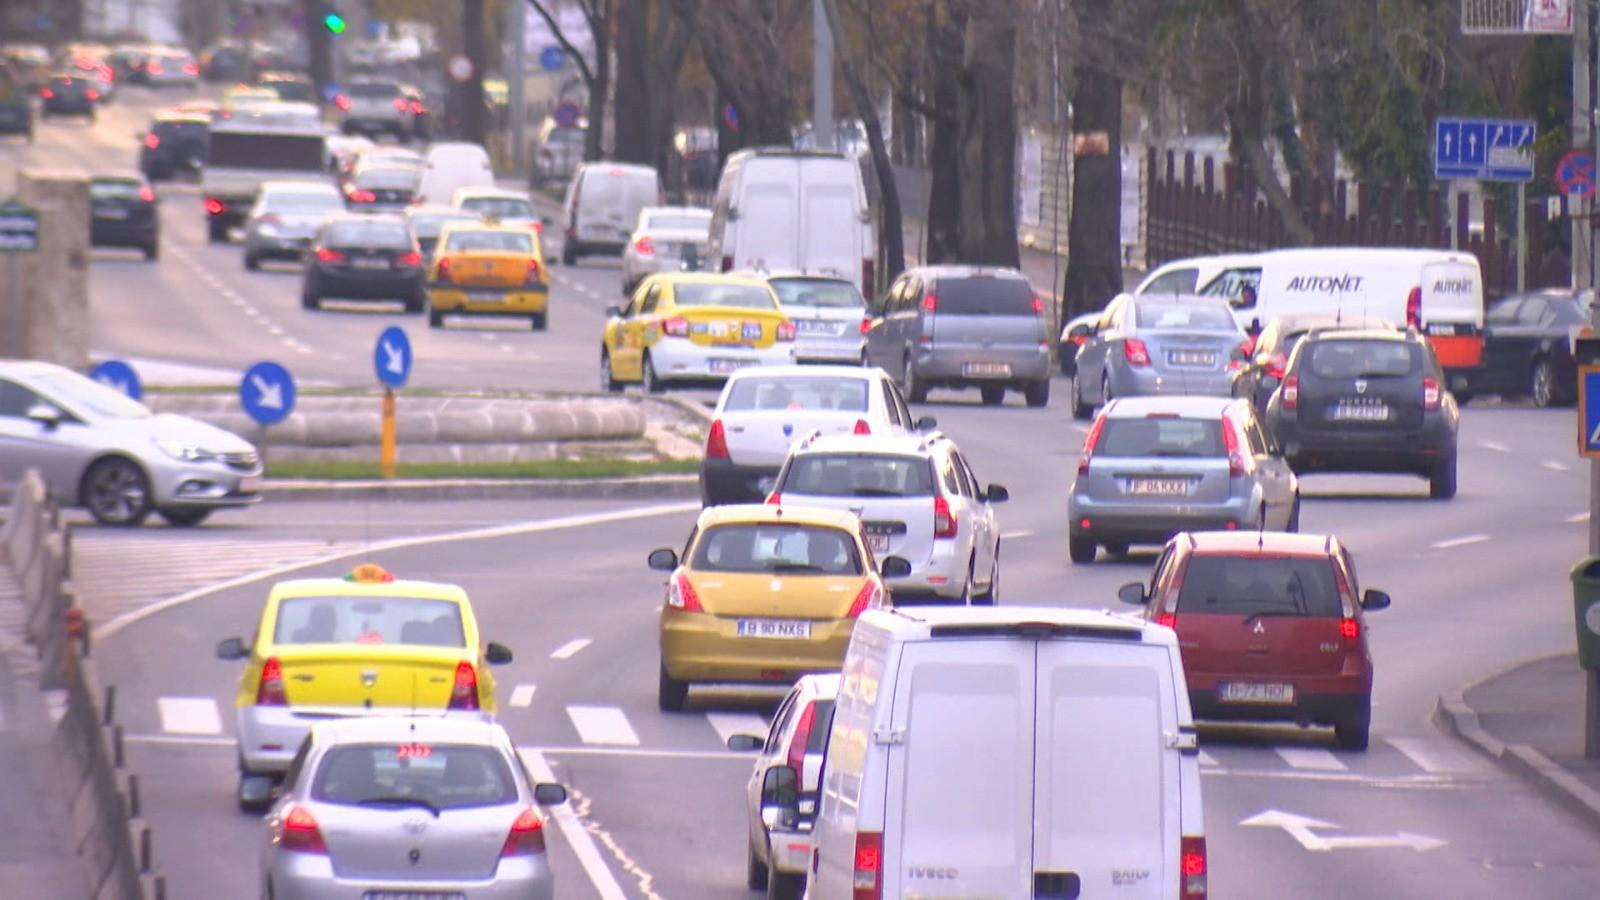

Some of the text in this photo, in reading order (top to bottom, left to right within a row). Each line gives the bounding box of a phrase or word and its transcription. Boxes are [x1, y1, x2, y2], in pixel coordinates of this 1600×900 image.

[1286, 273, 1364, 296] AUTONET
[1433, 279, 1472, 296] AUTONET
[761, 623, 775, 634] 90
[779, 624, 805, 636] NXS
[908, 867, 959, 880] IVECO
